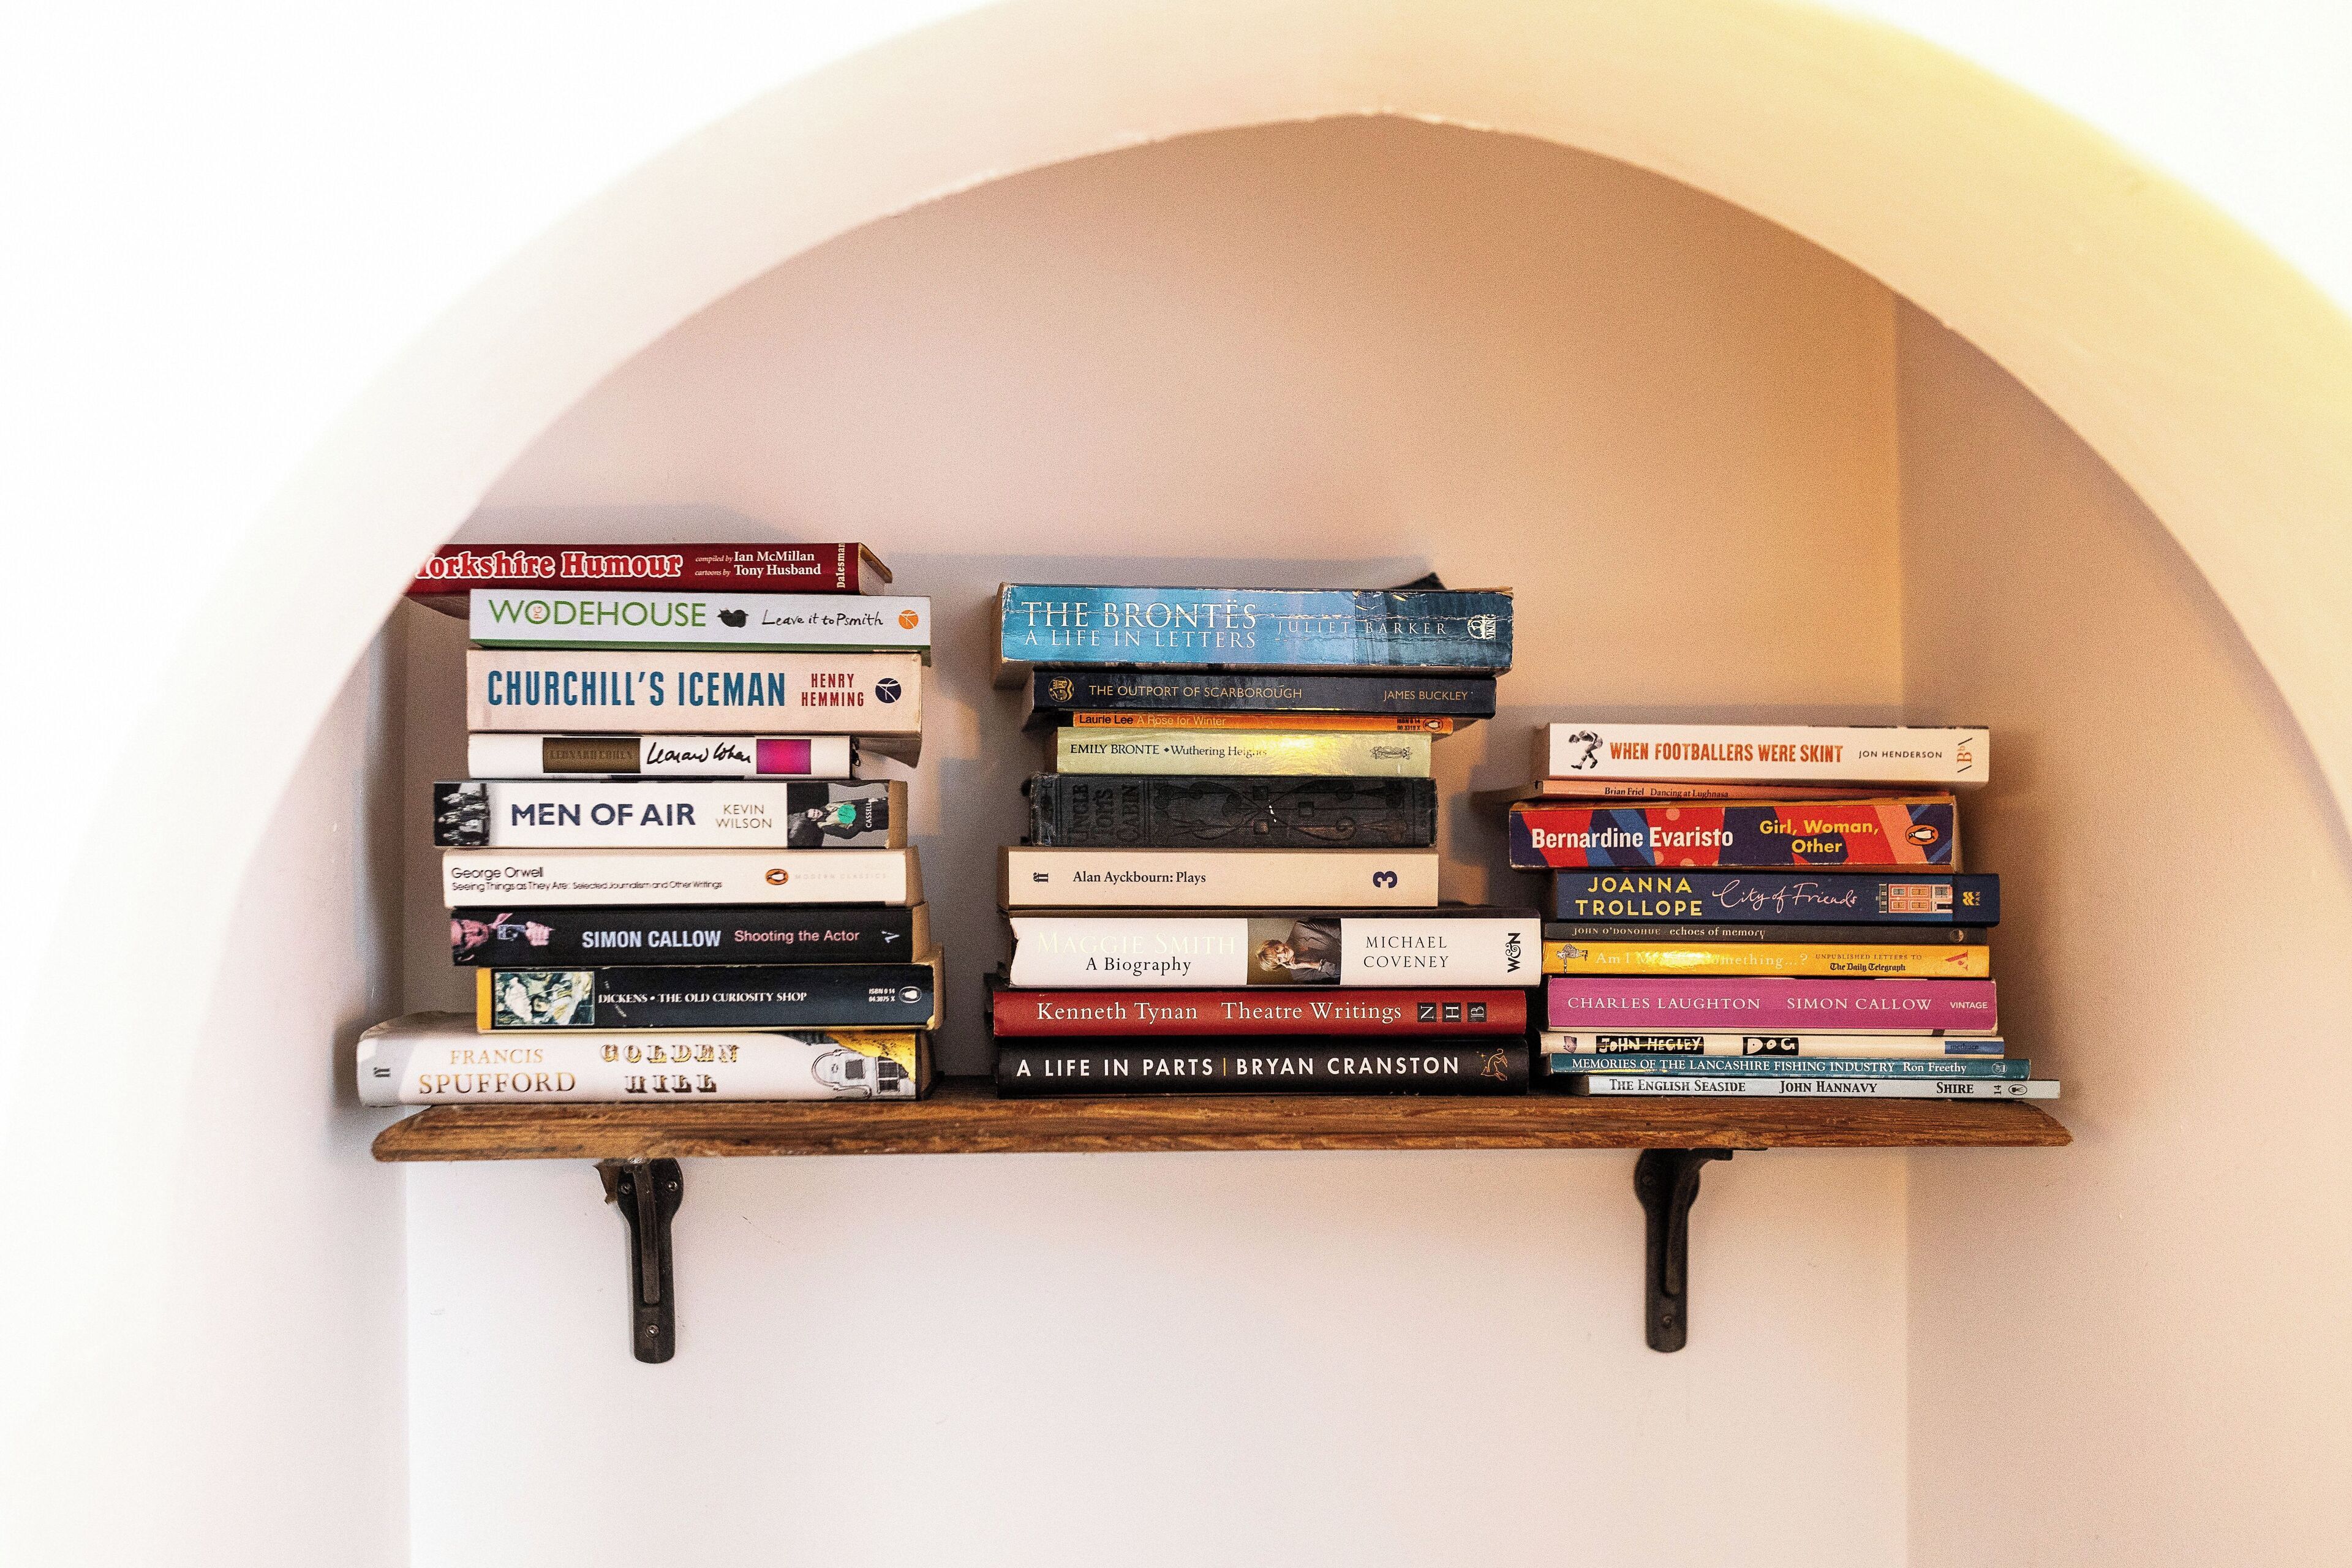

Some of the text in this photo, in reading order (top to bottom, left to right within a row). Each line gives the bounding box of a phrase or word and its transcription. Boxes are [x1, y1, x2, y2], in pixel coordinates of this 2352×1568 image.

[560, 551, 684, 579] Humour
[695, 551, 815, 564] compiled by Ian McMillan
[837, 542, 846, 589] Dalesman
[723, 568, 731, 578] by
[734, 564, 763, 579] Tony
[766, 564, 821, 575] Husband
[488, 599, 707, 627] WODEHOUSE
[761, 609, 883, 627] Leave it to Psmith
[1021, 598, 1257, 629] THE BRONTËS
[1277, 621, 1447, 635] JULIET BARKER
[1485, 614, 1495, 640] VIKING
[1024, 630, 1256, 649] A LIFE IN LETTERS
[488, 669, 785, 707] CHURCHILL'S ICEMAN
[811, 673, 855, 689] HENRY
[801, 690, 865, 707] HEMMING
[1089, 685, 1302, 699] THE OUTPORT OF SCARBOROUGH
[1383, 690, 1469, 701] JAMES BUCKLEY
[1079, 714, 1226, 726] Laurie Lee A Rose for Winter
[1070, 744, 1226, 758] EMILY BRONTE Wuthering
[1610, 742, 1844, 763] WHEN FOOTBALLERS WERE SKINT
[1859, 750, 1943, 759] JON HENDERSON
[1604, 787, 1626, 796] Brian
[1627, 787, 1644, 796] Friel
[1650, 788, 1681, 798] Dancing
[1692, 789, 1728, 799] Lughnasa
[511, 803, 696, 826] MEN OF AIR
[723, 804, 764, 815] KEVIN
[715, 818, 772, 829] WILSON
[1759, 820, 1879, 835] Girl, Woman,
[1532, 826, 1734, 849] Bernardine Evaristo
[1791, 839, 1843, 854] Other
[451, 866, 544, 880] George Orwell
[1072, 870, 1206, 886] Alan Ayckbourn: Plays
[1373, 870, 1398, 889] 3
[451, 882, 485, 892] Seeing
[486, 881, 515, 892] Things
[528, 881, 551, 891] They
[573, 881, 608, 889] Selected
[609, 881, 650, 889] Journalism
[669, 880, 692, 889] Other
[693, 880, 723, 890] Writings
[1588, 876, 1693, 894] JOANNA
[1712, 879, 1858, 913] City of Friends
[1575, 899, 1703, 917] TROLLOPE
[582, 930, 722, 948] SIMON CALLOW
[734, 930, 860, 944] Shooting the Actor
[1572, 926, 1766, 939] JOHN O'DONOHUE echoes of memory
[1038, 932, 1236, 955] MAGGIE SMITH
[1365, 936, 1448, 948] MICHAEL
[1085, 956, 1191, 976] A Biography
[1363, 955, 1449, 968] COVENEY
[1594, 952, 1621, 964] Am
[1830, 962, 1906, 973] The Daily Telegraph
[598, 992, 807, 1003] DICKENS THE OLD CURIOSITY SHOP
[1567, 997, 1932, 1011] CHARLES LAUGHTON SIMON CALLOW
[1950, 1001, 1989, 1010] VINTAGE
[1037, 1001, 1402, 1025] Kenneth Tynan Theatre Writings
[450, 1048, 544, 1065] FRANCIS
[599, 1044, 740, 1063] GOLDEN
[1016, 1057, 1458, 1077] A LIFE IN PARTS BRYAN CRANSTON
[1572, 1058, 1967, 1074] MEMORIES OF THE LANCASHIRE FISHING INDUSTRY Ron Freethy
[418, 1072, 576, 1095] SPUFFORD
[624, 1074, 718, 1093] HILL
[1609, 1079, 1746, 1092] THE ENGLISH SEASIDE
[1779, 1081, 1878, 1094] JOHN HANNAVY
[1936, 1082, 1974, 1094] SHIRE
